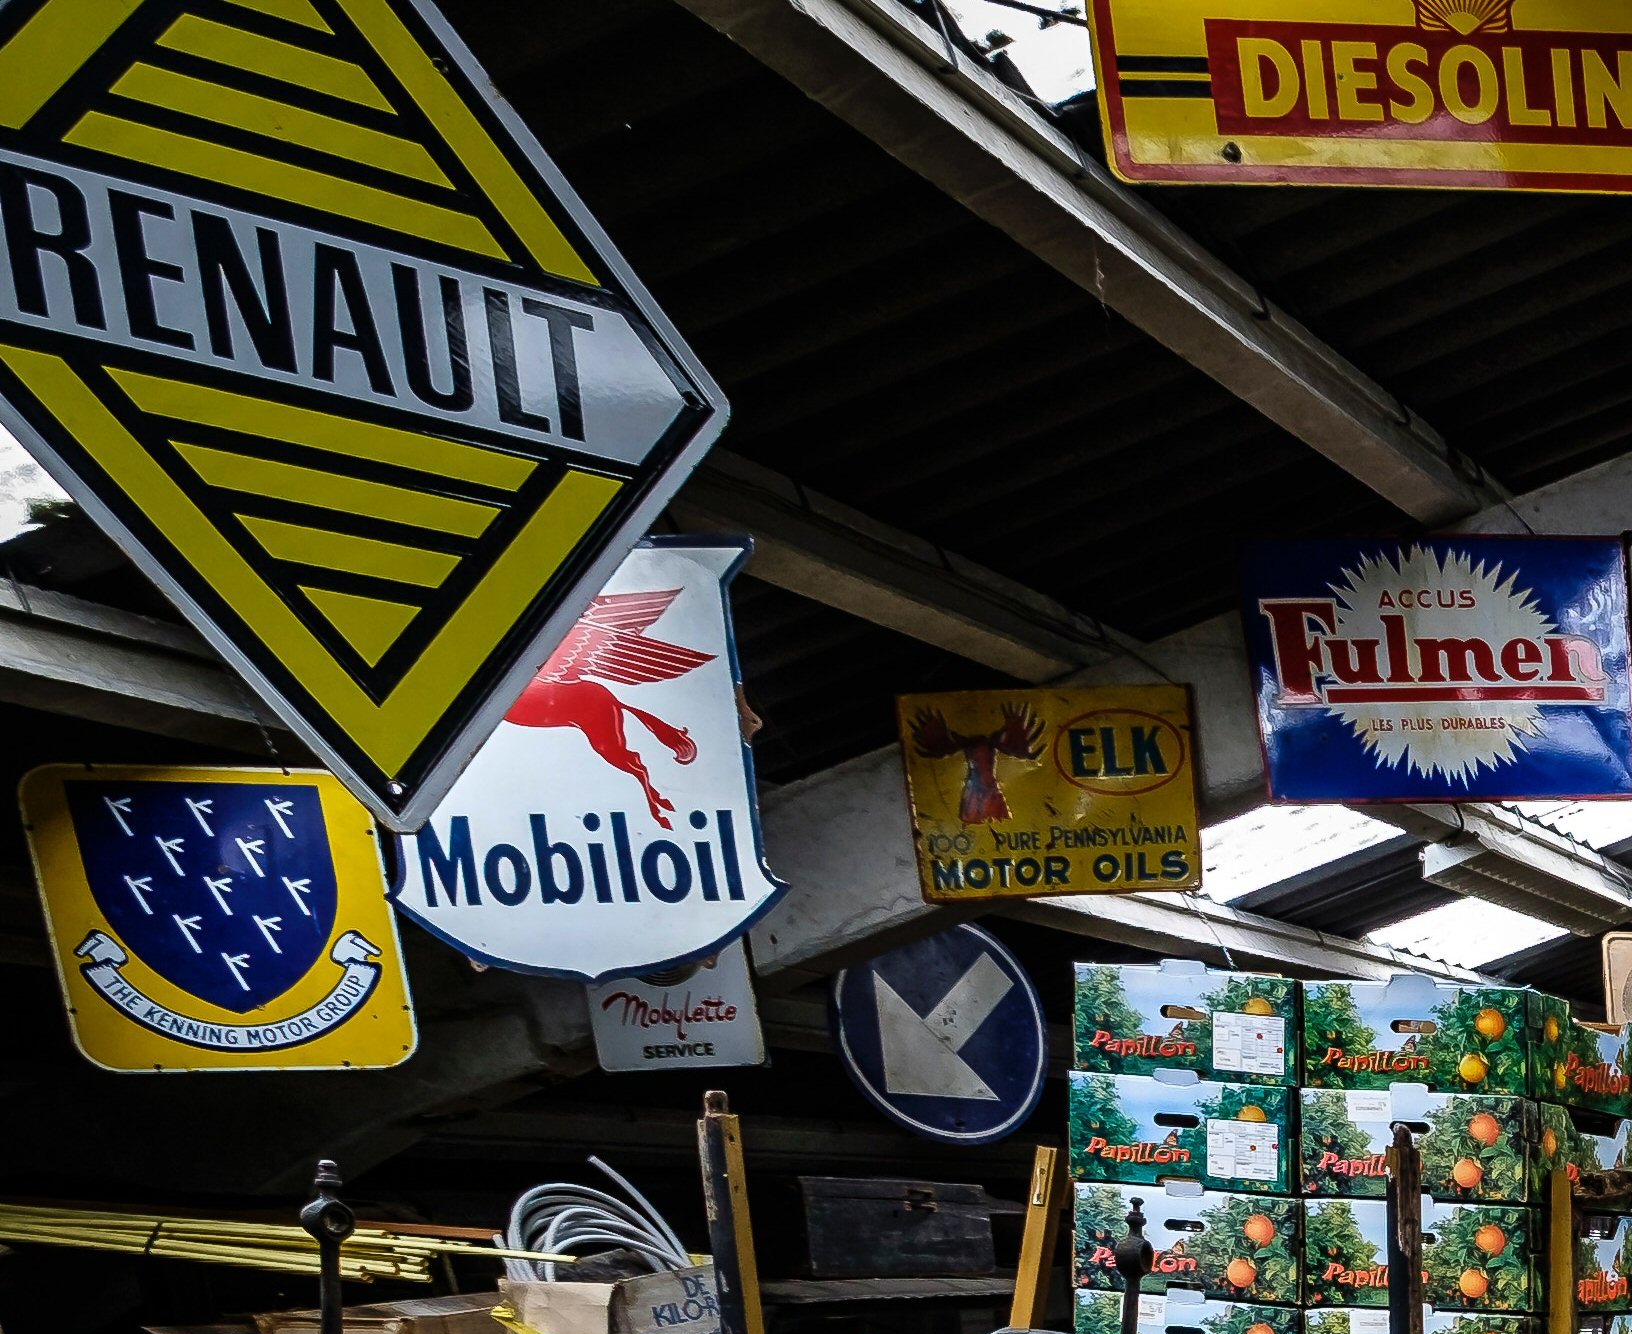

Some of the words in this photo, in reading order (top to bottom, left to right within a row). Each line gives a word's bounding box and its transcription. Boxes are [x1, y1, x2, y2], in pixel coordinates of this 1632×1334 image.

[0, 170, 596, 443] RENAULT
[1378, 589, 1477, 609] ACCUS
[1372, 718, 1393, 731] LES
[1401, 718, 1434, 731] PLUS
[1441, 717, 1506, 731] DURABLES
[1067, 725, 1168, 777] ELK
[995, 831, 1042, 851] PURE
[1050, 824, 1188, 850] PENNSYLVANIA
[416, 810, 746, 908] Mobiloil
[930, 856, 1071, 892] MOTOR
[1092, 849, 1190, 883] OILS
[104, 975, 137, 1010] THE
[144, 1006, 240, 1046] KENNING
[246, 1018, 321, 1047] MOTOR
[317, 974, 364, 1024] GROUP
[601, 990, 738, 1041] Mobylette
[643, 1042, 716, 1060] SERVICE
[1090, 1030, 1196, 1057] Papillon
[1321, 1047, 1429, 1074] Papillon
[1567, 1051, 1632, 1094] Papillon
[1084, 1137, 1190, 1164] Papillon
[1317, 1151, 1392, 1178] Papill
[681, 1274, 710, 1299] DE
[1578, 1270, 1629, 1304] apillon
